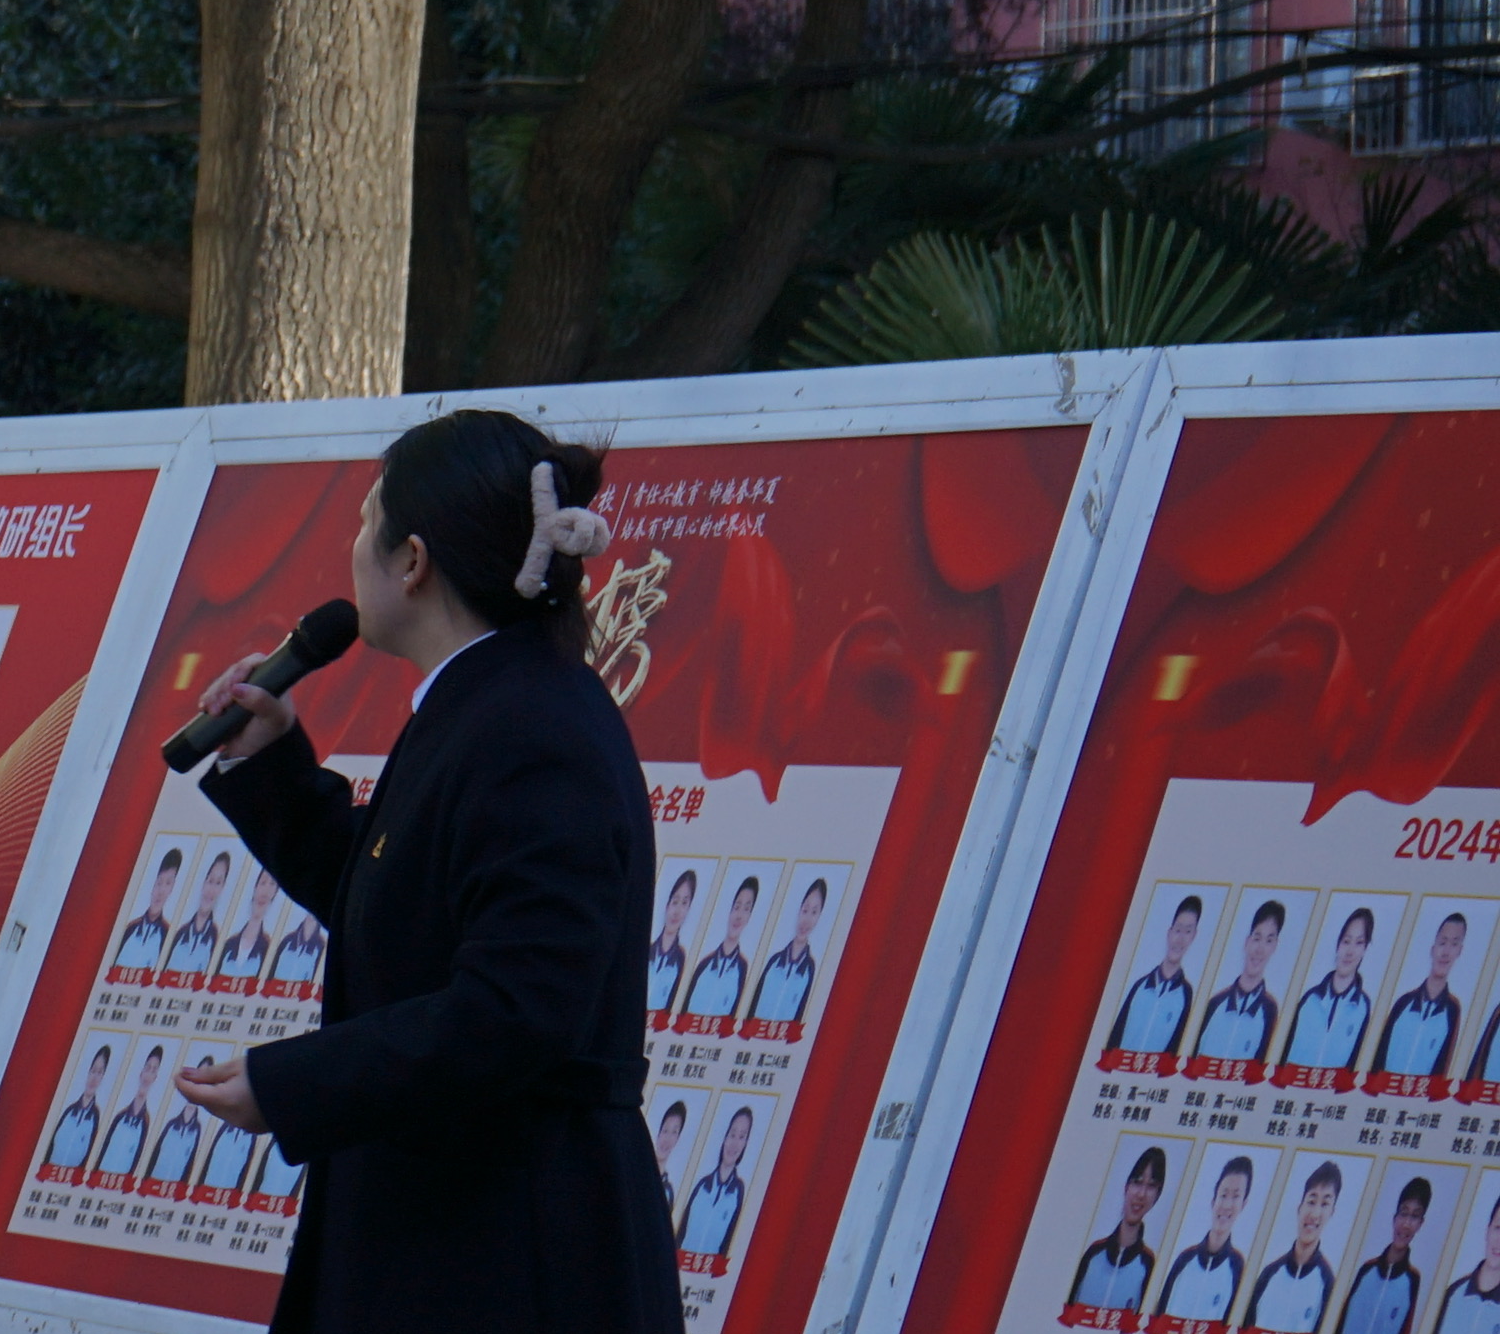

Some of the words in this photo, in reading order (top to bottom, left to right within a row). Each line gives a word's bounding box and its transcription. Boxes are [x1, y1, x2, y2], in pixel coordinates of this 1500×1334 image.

[689, 1016, 722, 1035] 三等奖
[755, 1021, 790, 1040] 三等奖
[1117, 1052, 1161, 1073] 三等奖
[1204, 1059, 1247, 1081] 三等奖
[1292, 1068, 1337, 1089] 三等奖
[1385, 1075, 1431, 1097] 三等奖
[1099, 1083, 1170, 1104] 班级：高一(4)班
[1184, 1090, 1257, 1112] 班级：高一(4)班
[681, 1253, 716, 1273] 三等奖
[1081, 1308, 1123, 1330] 二等奖
